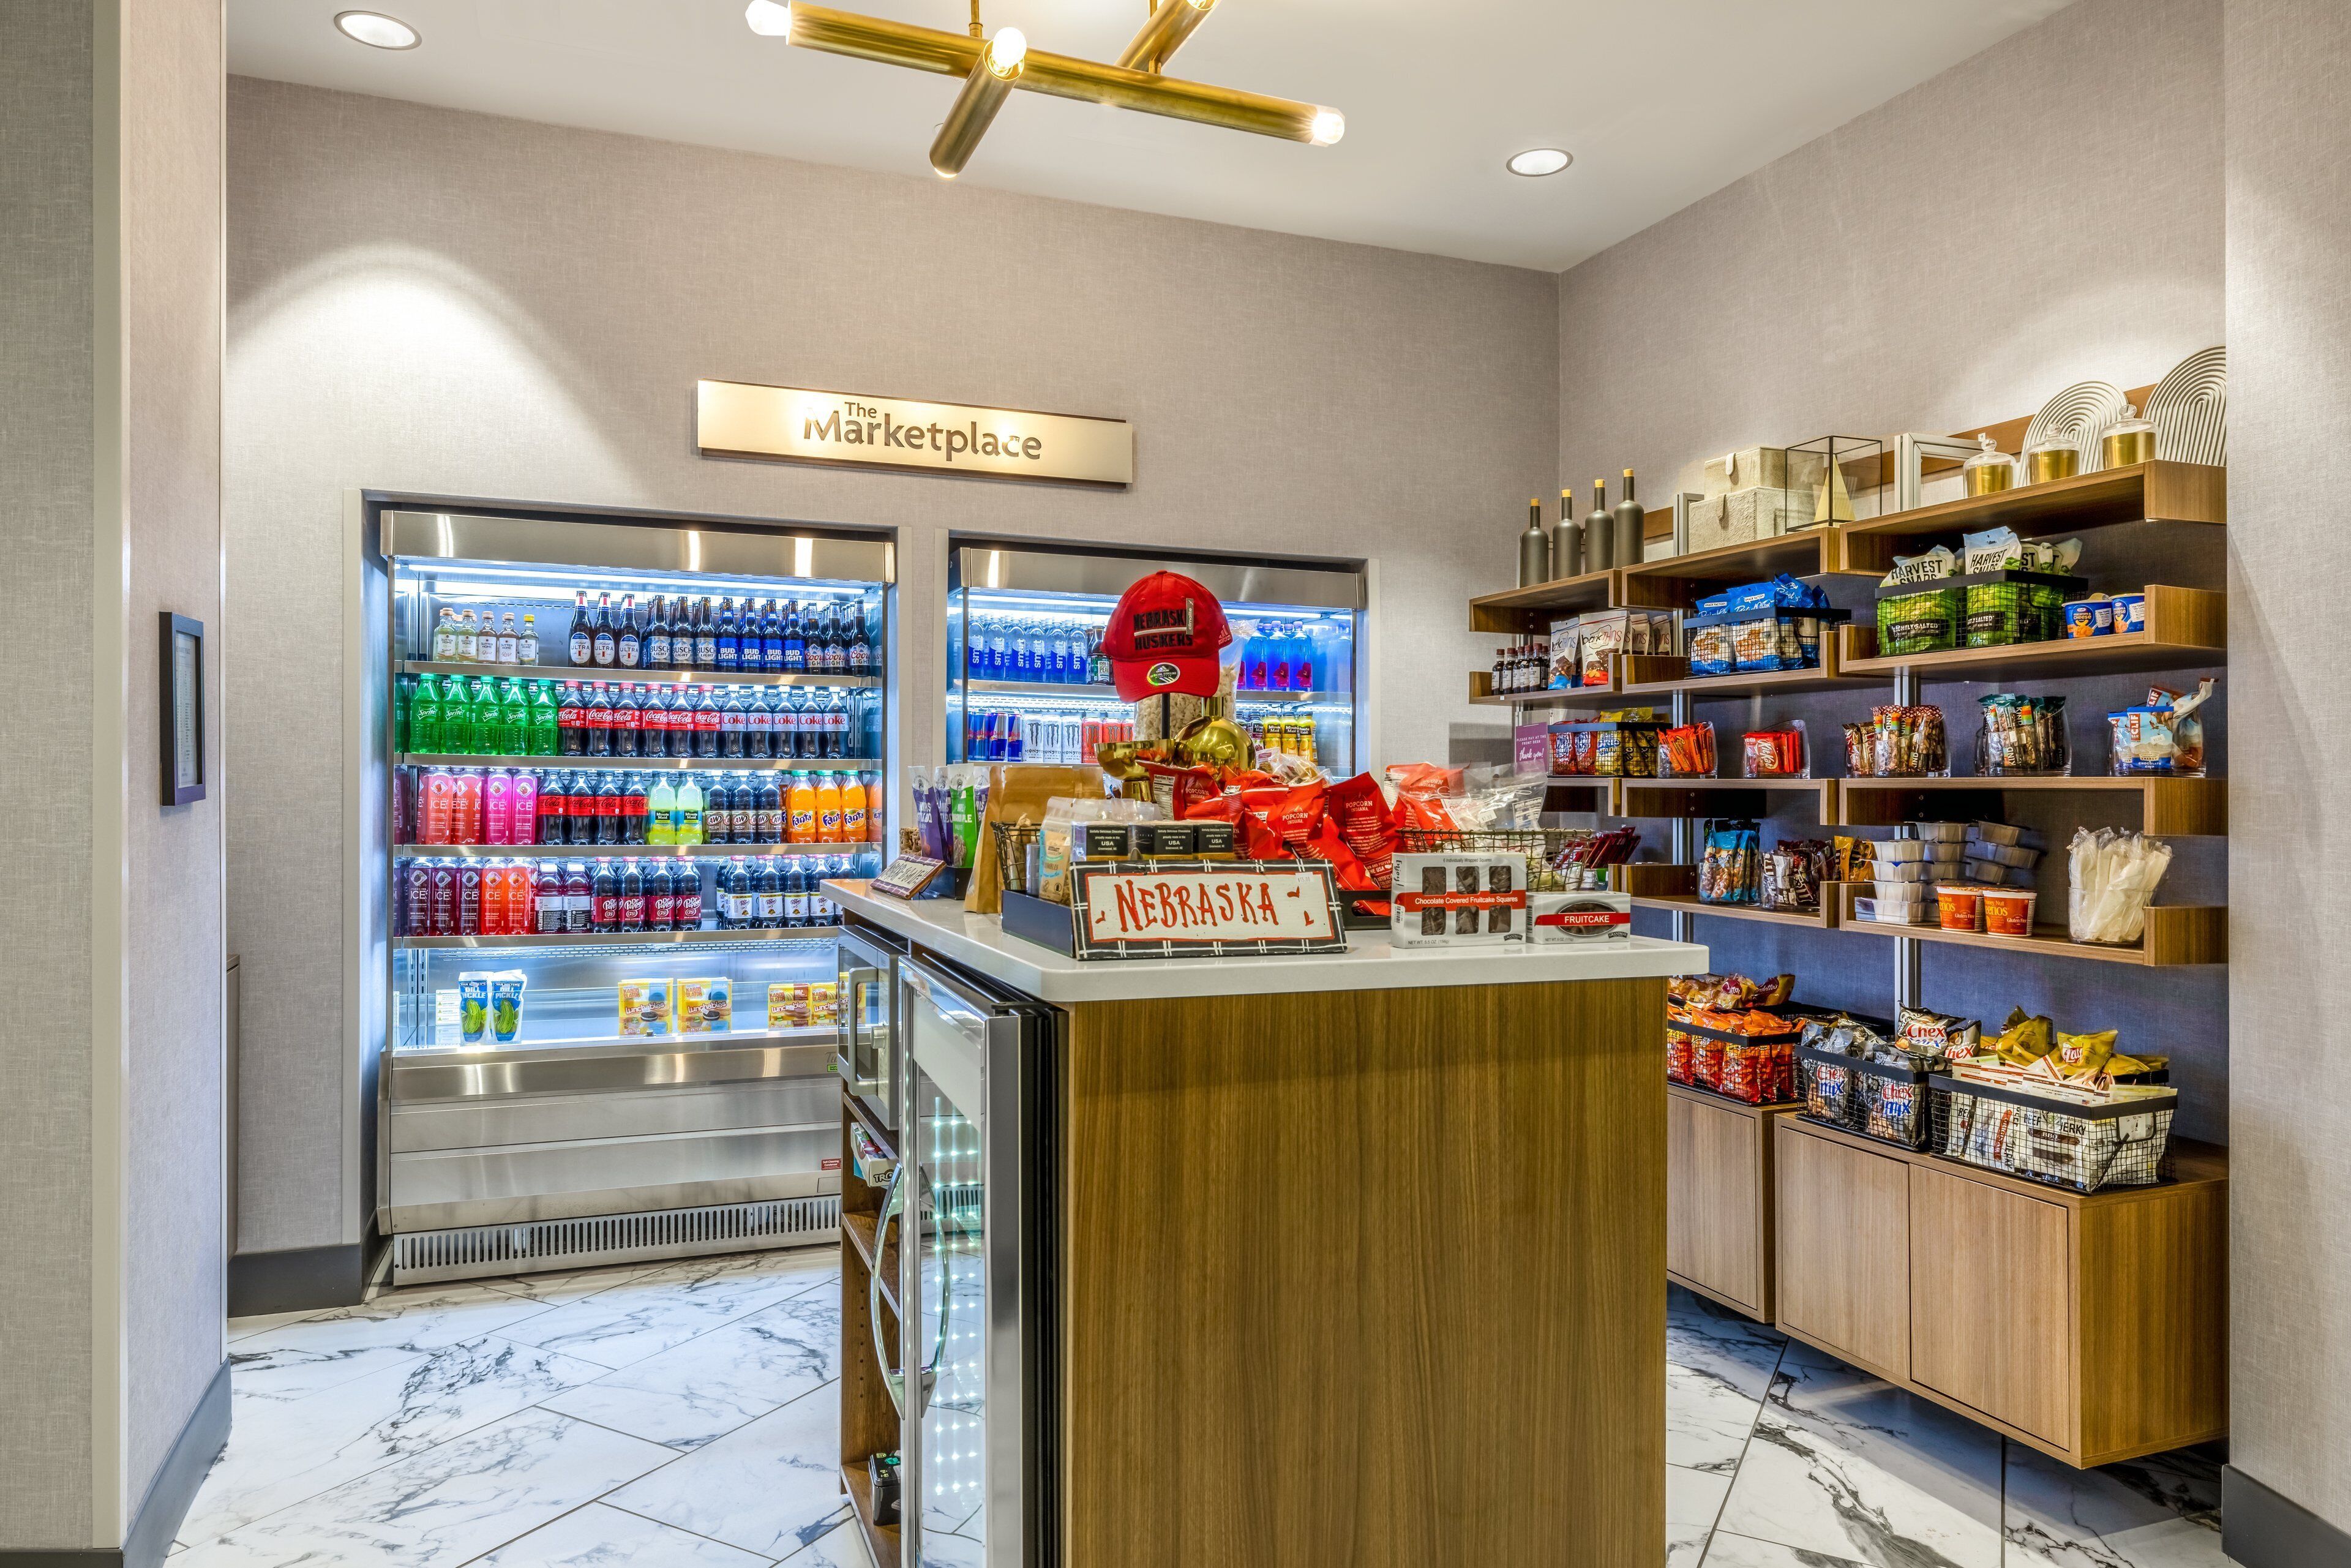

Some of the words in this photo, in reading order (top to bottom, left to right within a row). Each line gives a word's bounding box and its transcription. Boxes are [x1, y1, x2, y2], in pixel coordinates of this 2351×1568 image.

[844, 402, 877, 419] The
[803, 407, 1042, 462] Marketplace
[1970, 549, 2008, 568] HARVEST
[1891, 559, 1943, 580] HARVEST
[1134, 633, 1193, 651] HUSKERS
[1581, 629, 1622, 645] barkTHINS
[722, 715, 745, 725] Coke
[748, 715, 771, 725] Coke
[774, 715, 796, 725] Coke
[800, 715, 822, 725] Coke
[823, 715, 846, 725] Coke
[1519, 747, 1532, 761] thank
[1533, 748, 1544, 761] you!
[2007, 747, 2016, 766] KIND
[430, 800, 446, 809] ICE
[792, 812, 812, 826] Fanta
[844, 811, 864, 825] Fanta
[410, 890, 426, 899] ICE
[435, 891, 451, 900] ICE
[462, 891, 478, 900] ICE
[486, 891, 500, 900] ICE
[509, 891, 525, 900] ICE
[624, 901, 643, 911] Pepper
[656, 899, 673, 910] Pepper
[684, 899, 701, 910] Pepper
[1114, 879, 1280, 932] NEBRASKA
[1906, 1024, 1947, 1038] Chex
[1817, 1065, 1847, 1080] Chex
[1882, 1083, 1914, 1100] Chex
[2023, 1111, 2042, 1127] BEEF
[2058, 1118, 2087, 1136] JERKY
[1995, 1117, 2009, 1157] ORIGINAL
[2042, 1131, 2058, 1140] BBQ
